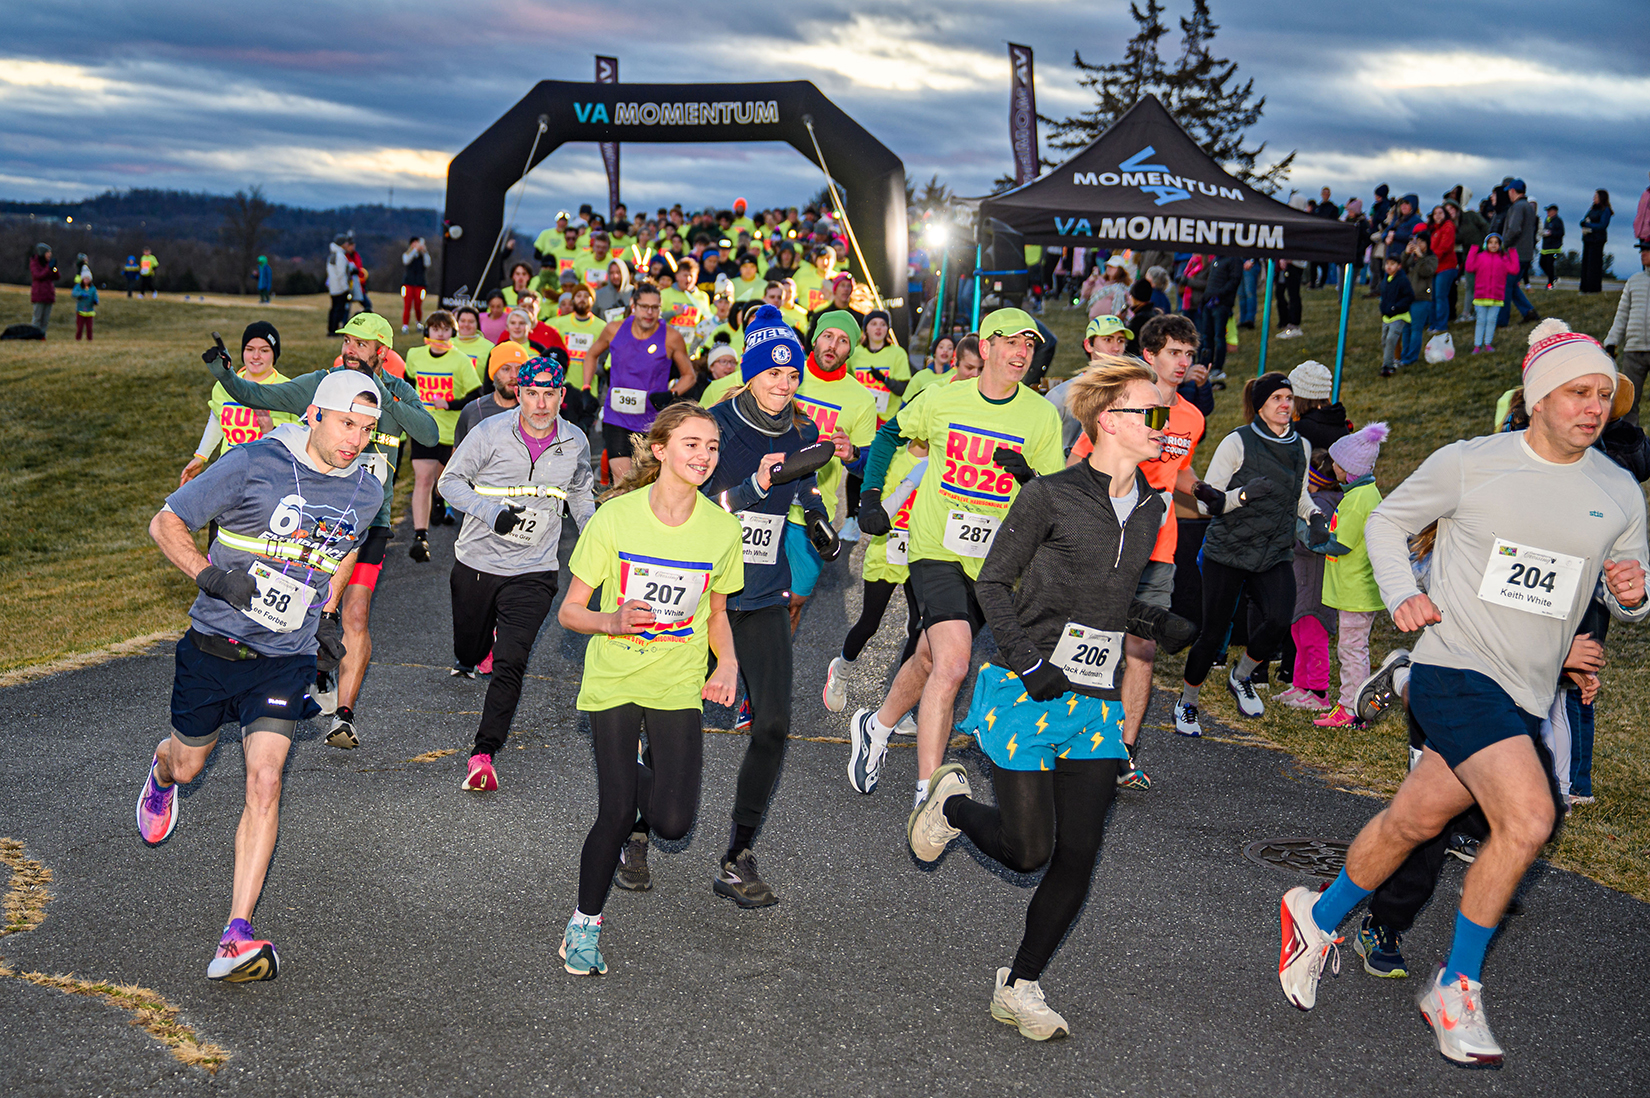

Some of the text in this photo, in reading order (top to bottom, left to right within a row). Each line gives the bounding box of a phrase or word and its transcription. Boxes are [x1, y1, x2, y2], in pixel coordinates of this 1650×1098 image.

[573, 101, 780, 125] VA MOMENTUM
[1073, 171, 1245, 201] MOMENTUM
[1053, 215, 1285, 249] VA MOMENTUM
[416, 375, 454, 390] RUN
[619, 395, 637, 406] 395
[941, 459, 1015, 494] 2026
[269, 494, 308, 536] 6
[1589, 510, 1604, 518] stio
[743, 526, 772, 547] 203
[959, 525, 992, 543] 287
[1506, 563, 1557, 593] 204
[263, 587, 292, 613] 58
[643, 582, 686, 605] 207
[1500, 588, 1552, 608] Keith White
[263, 610, 288, 627] Forbes
[664, 608, 684, 617] White
[1071, 644, 1110, 667] 206
